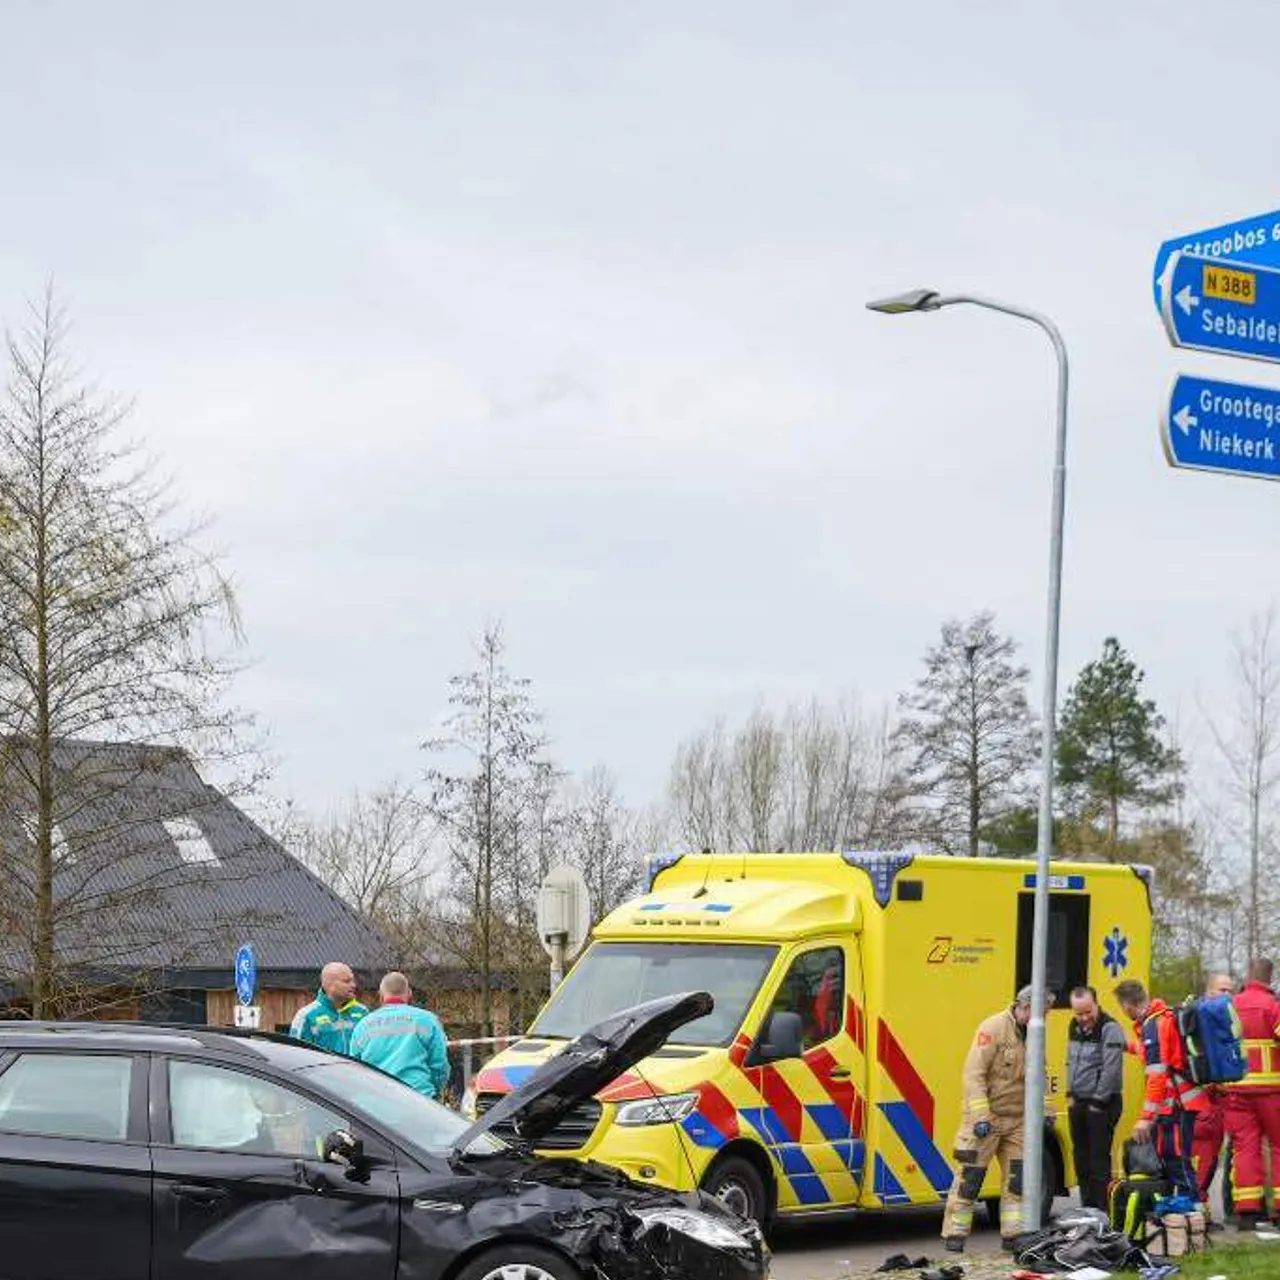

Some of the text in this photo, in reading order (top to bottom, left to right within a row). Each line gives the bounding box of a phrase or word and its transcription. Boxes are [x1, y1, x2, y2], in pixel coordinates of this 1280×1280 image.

[1206, 272, 1252, 297] N 388
[1199, 429, 1275, 461] Niekerk
